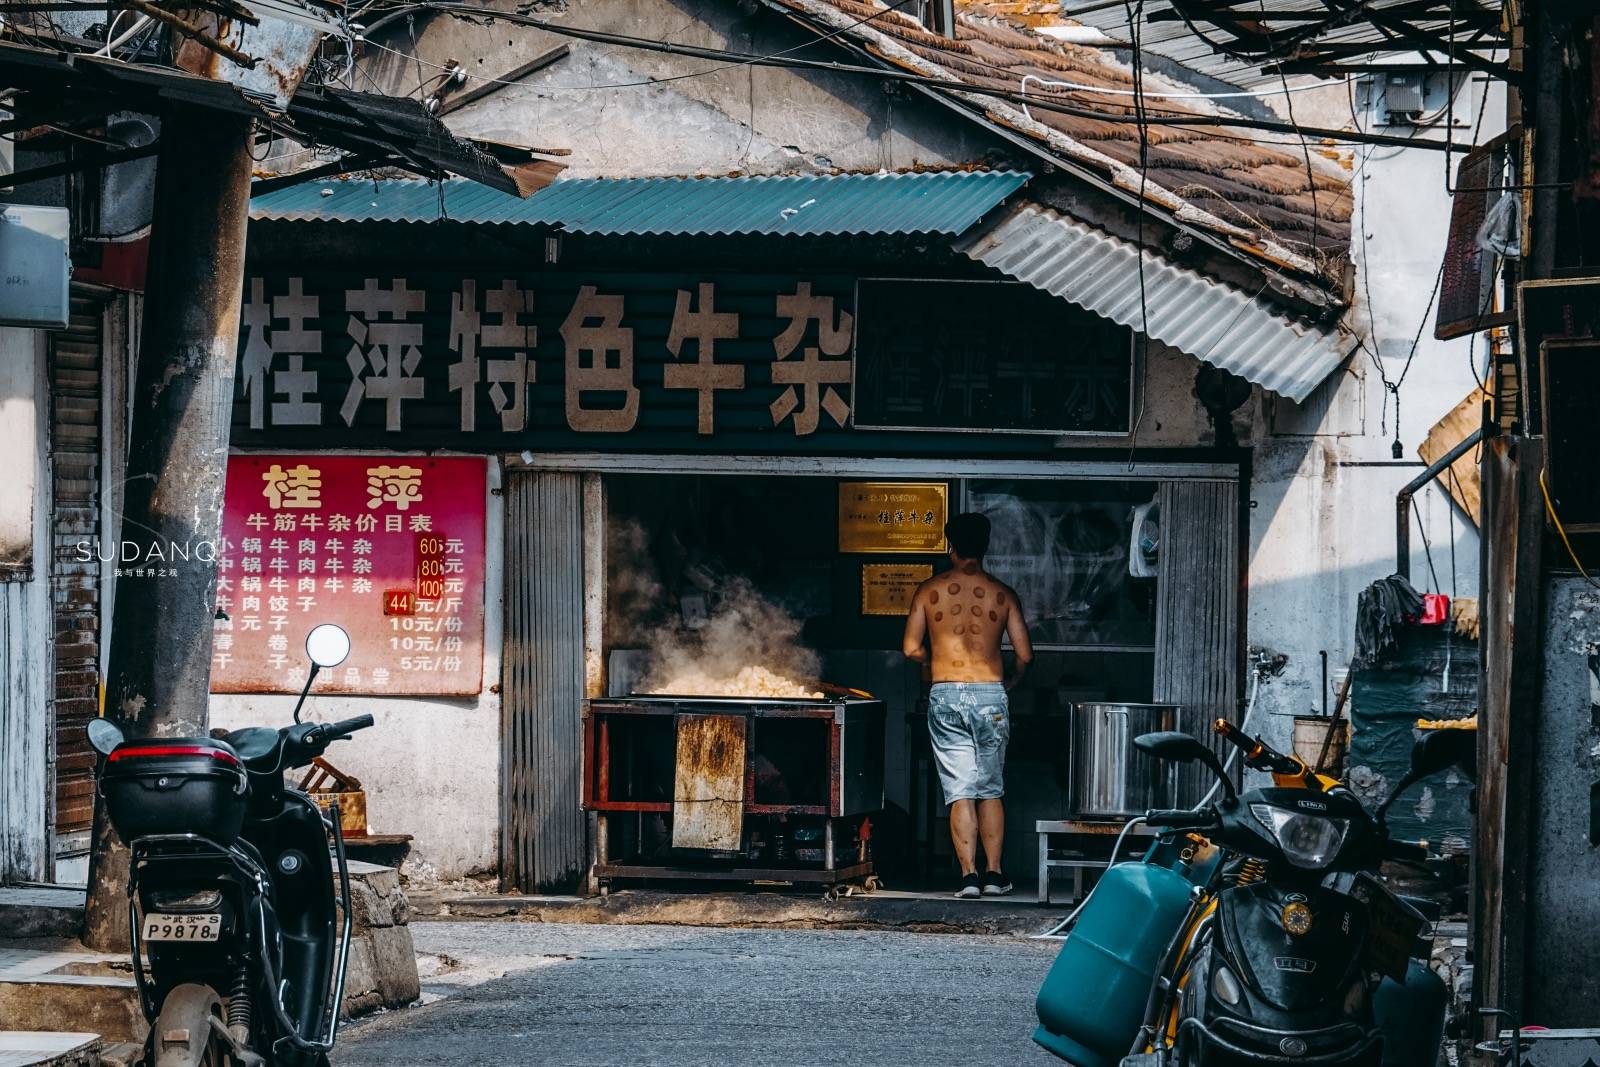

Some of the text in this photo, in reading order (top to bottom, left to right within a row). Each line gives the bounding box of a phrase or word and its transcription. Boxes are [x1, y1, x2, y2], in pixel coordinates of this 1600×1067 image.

[243, 277, 854, 435] 桂萍特色牛杂
[262, 464, 423, 510] 桂萍
[246, 513, 433, 533] 牛筋牛杂价目表
[216, 557, 373, 574] 中锅牛肉牛杂
[216, 576, 373, 593] 大锅牛肉牛杂
[388, 616, 464, 632] 10元/份
[388, 636, 464, 652] 10元/份
[400, 656, 463, 672] 5元/份
[173, 916, 196, 924] 武汉
[147, 924, 212, 939] P9878
